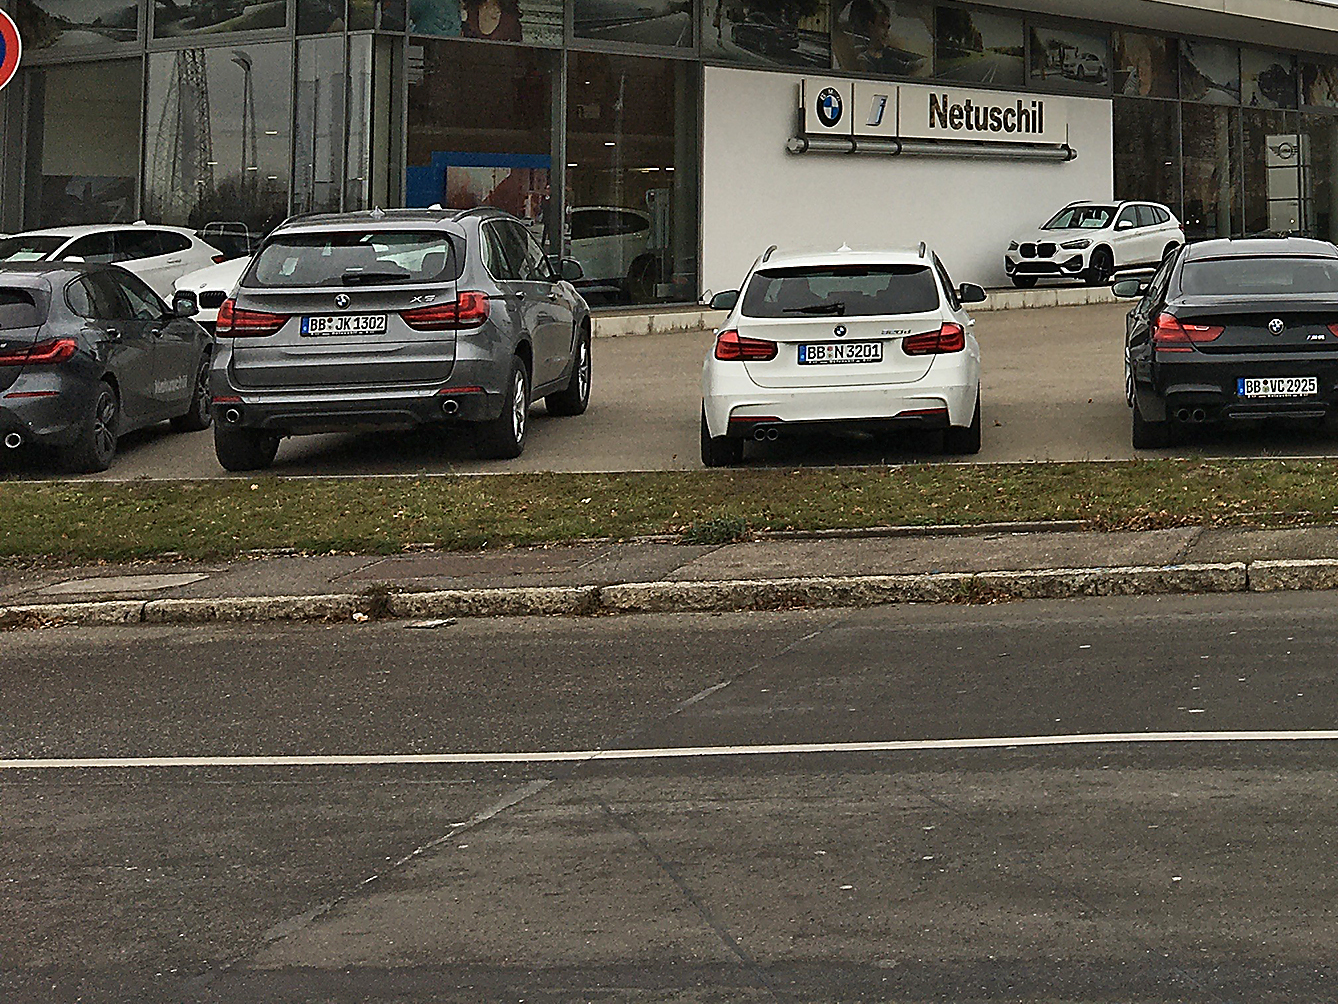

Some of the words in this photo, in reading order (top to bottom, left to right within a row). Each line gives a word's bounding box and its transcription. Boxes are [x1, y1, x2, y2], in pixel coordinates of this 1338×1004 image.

[928, 93, 1044, 134] Netuschil
[310, 318, 326, 331] BB
[335, 317, 352, 331] JK
[353, 316, 385, 330] 1302
[807, 346, 826, 360] BB
[834, 345, 844, 359] N
[846, 344, 880, 358] 3201
[1246, 380, 1261, 394] BB
[1269, 379, 1285, 393] VC
[1286, 378, 1315, 392] 2925
